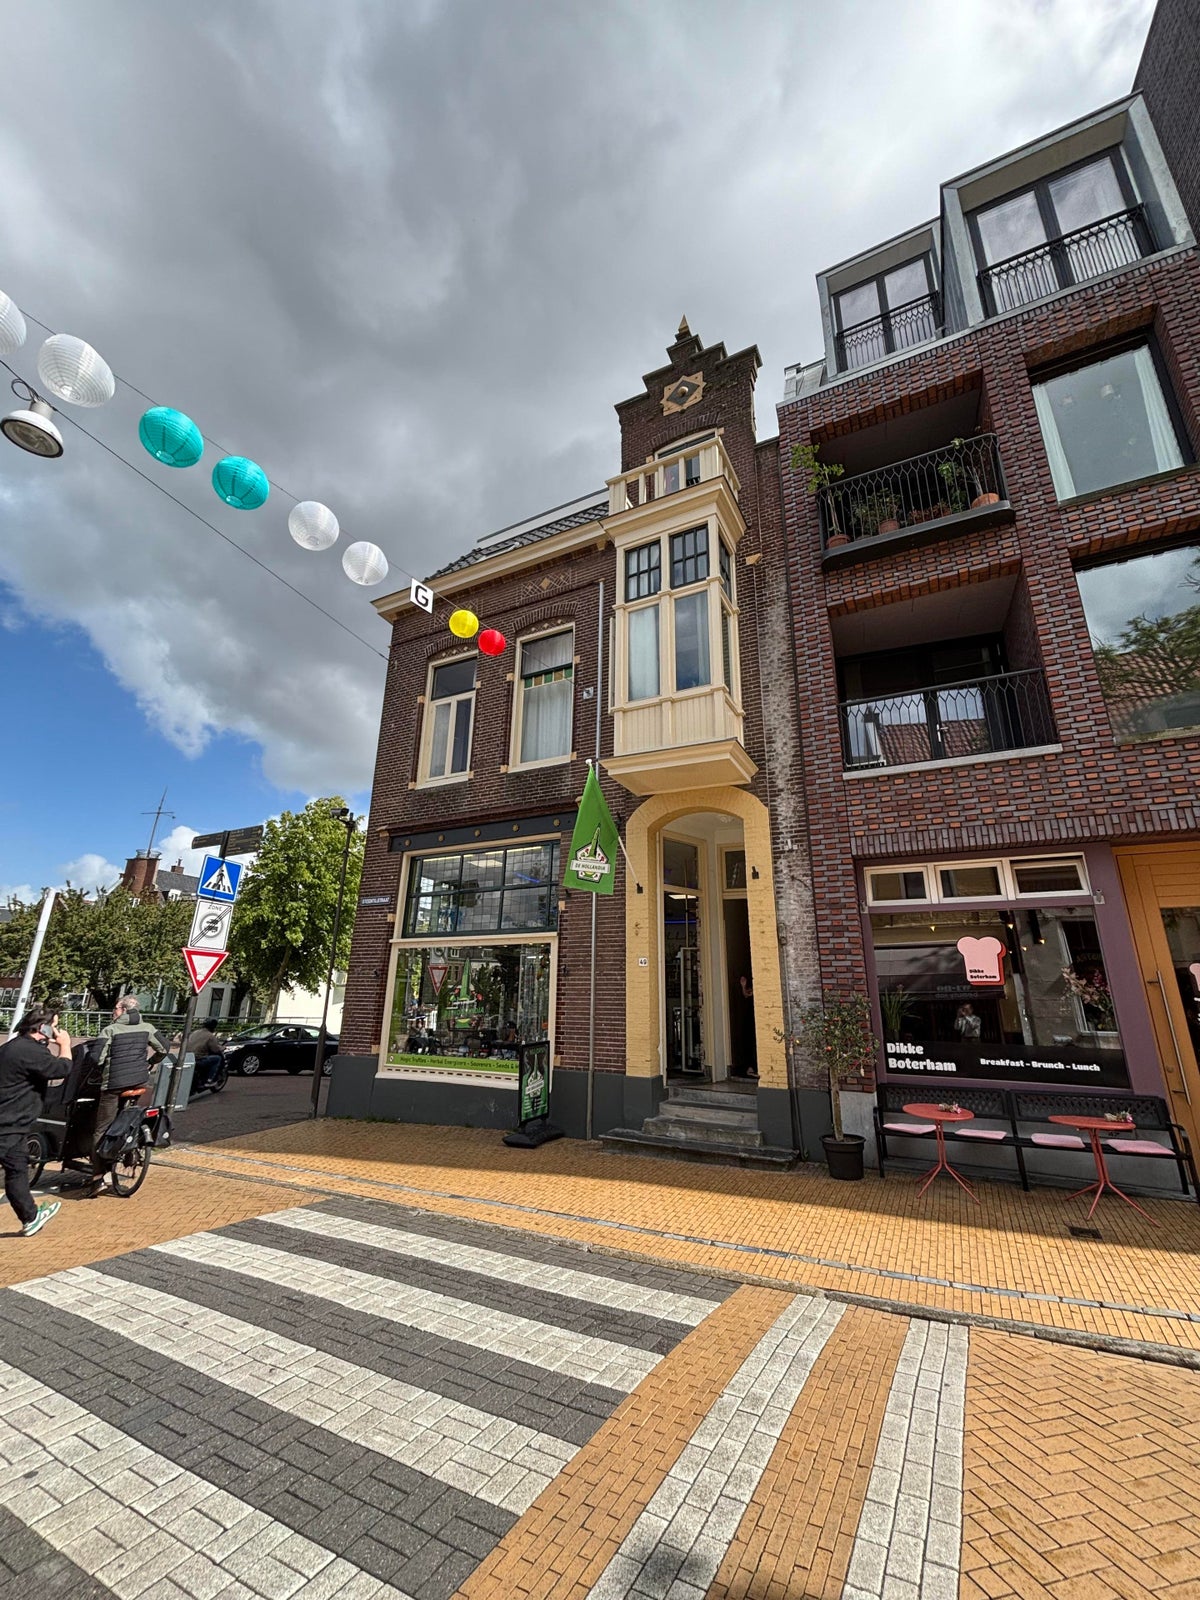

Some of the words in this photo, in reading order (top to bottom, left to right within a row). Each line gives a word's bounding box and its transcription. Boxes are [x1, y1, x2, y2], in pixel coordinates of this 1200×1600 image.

[415, 584, 429, 607] G
[208, 904, 223, 912] ZONE
[887, 1042, 924, 1055] Dikke
[888, 1058, 957, 1072] Boterham
[980, 1058, 1025, 1067] Breakfast
[1031, 1060, 1065, 1070] Brunch
[1072, 1063, 1101, 1072] Lunch
